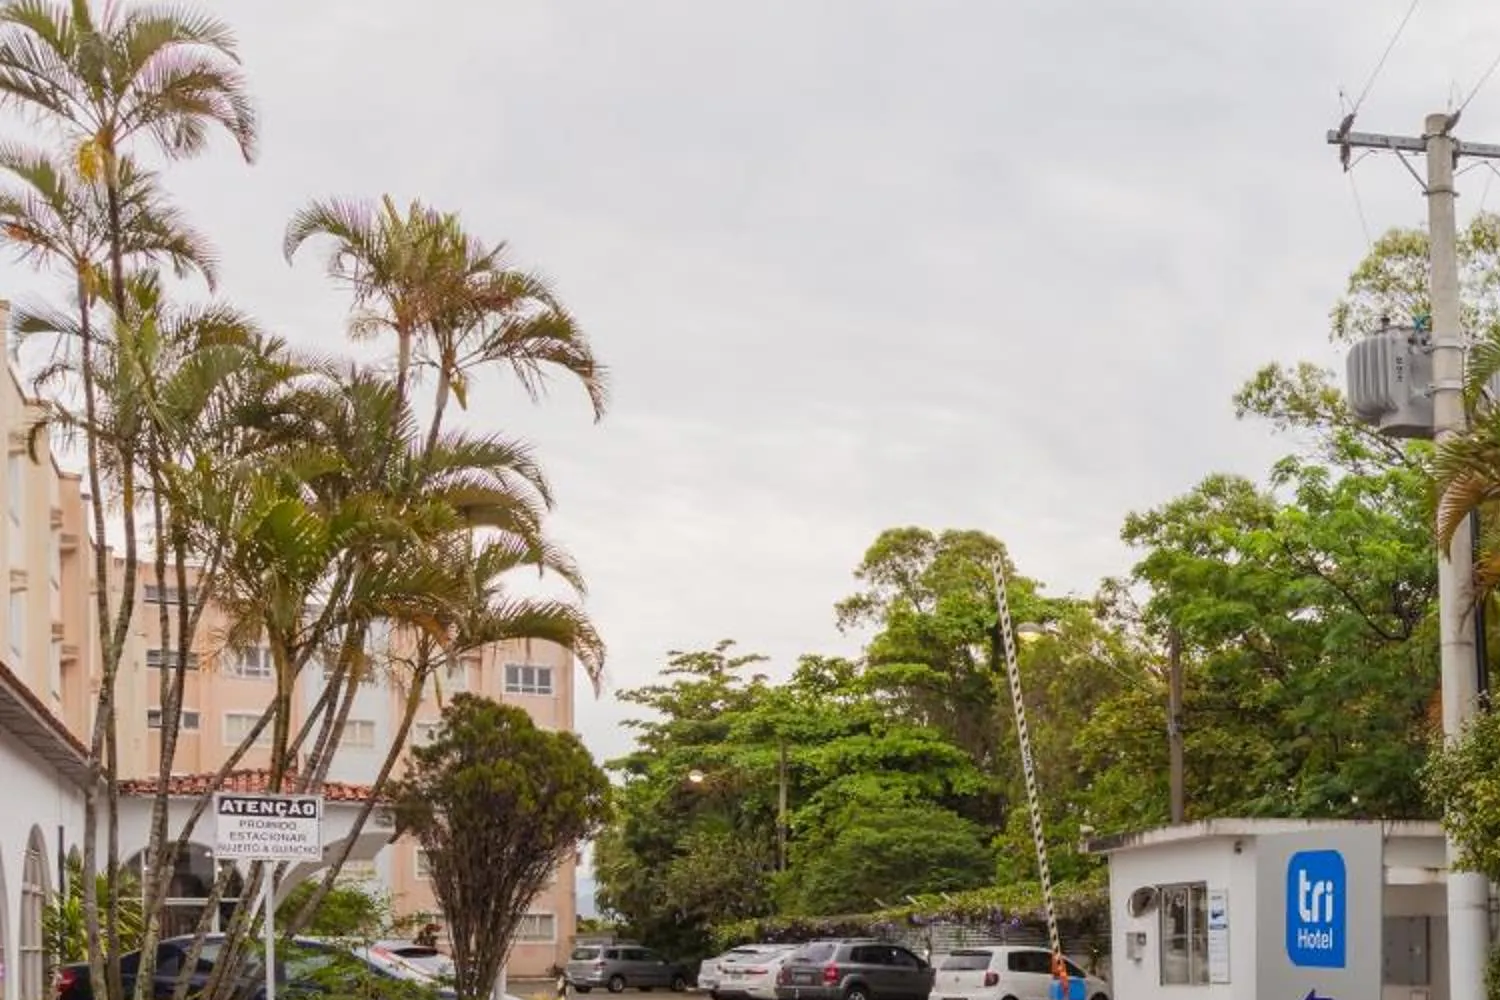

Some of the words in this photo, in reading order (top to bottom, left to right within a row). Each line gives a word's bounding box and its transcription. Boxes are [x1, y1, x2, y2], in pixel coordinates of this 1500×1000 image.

[221, 798, 314, 816] ATENÇÃO
[229, 832, 307, 843] ESTACIONAR
[1299, 869, 1333, 923] tri
[1297, 927, 1333, 950] Hotel
